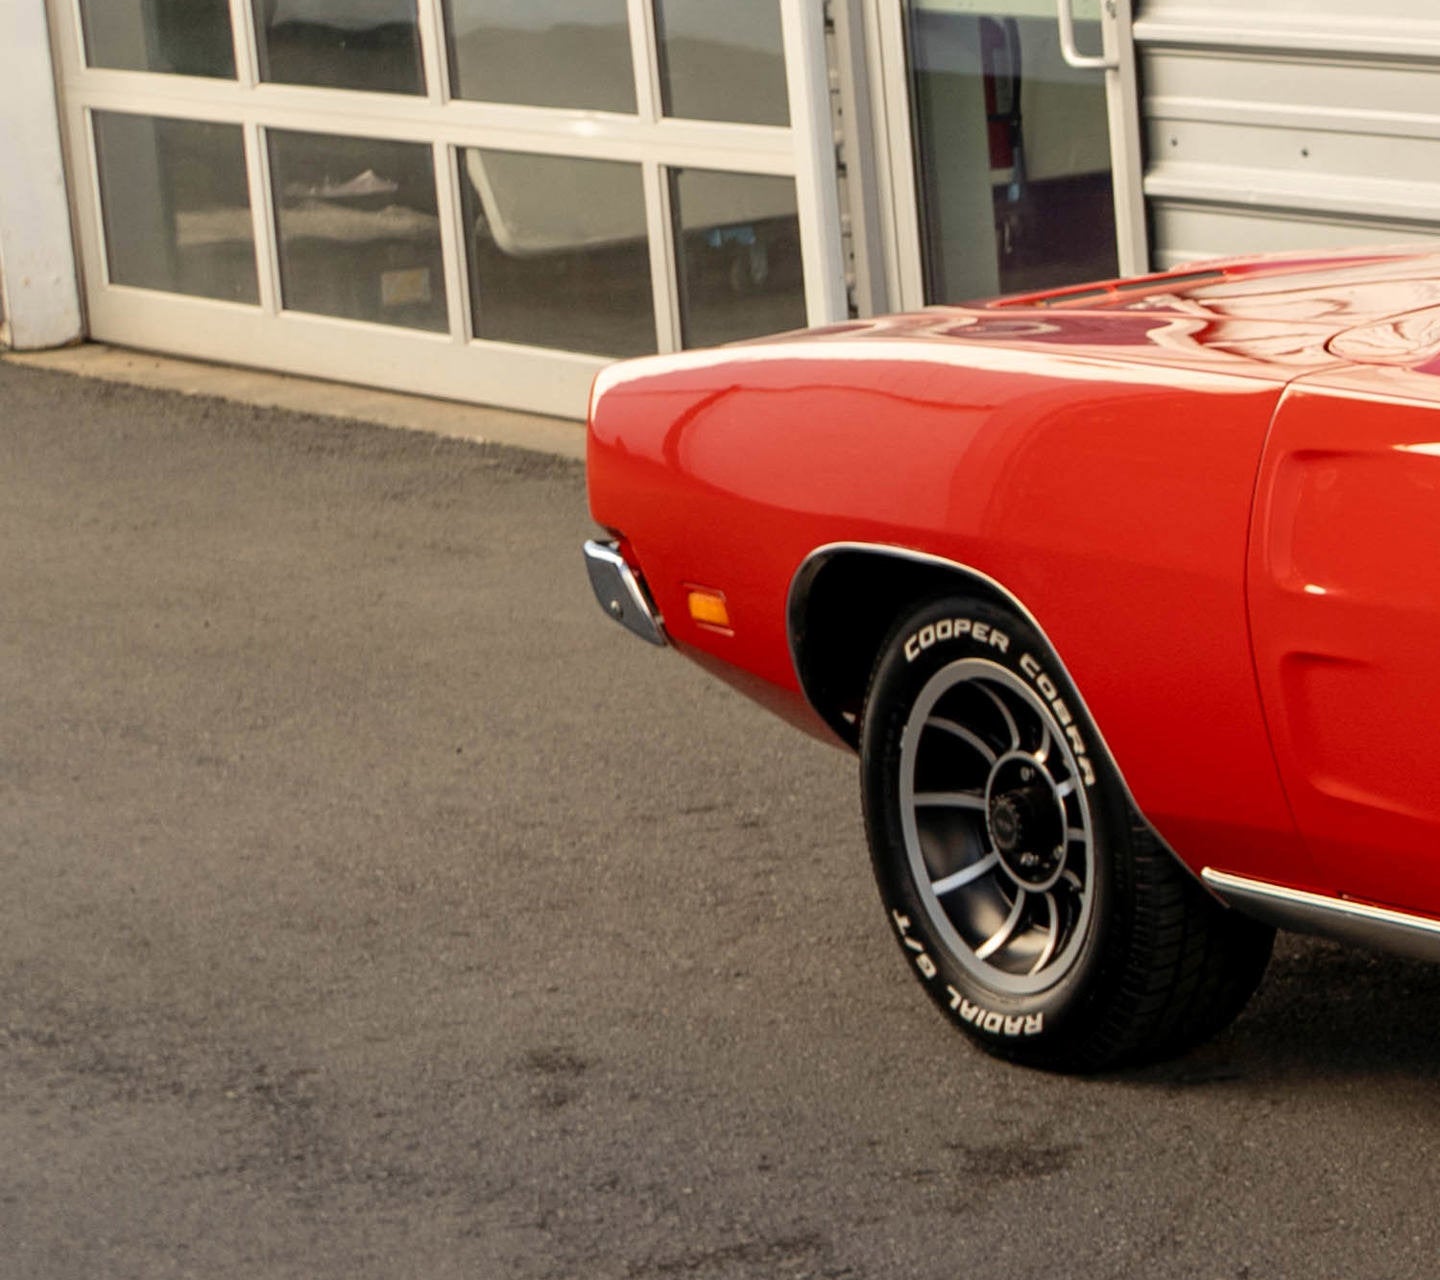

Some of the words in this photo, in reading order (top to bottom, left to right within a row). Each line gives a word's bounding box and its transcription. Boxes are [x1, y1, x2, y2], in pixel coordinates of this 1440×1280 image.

[904, 619, 1009, 661] COOPER
[1020, 654, 1095, 790] COBRA
[893, 910, 936, 981] G/T
[947, 985, 1043, 1035] RADIAL
